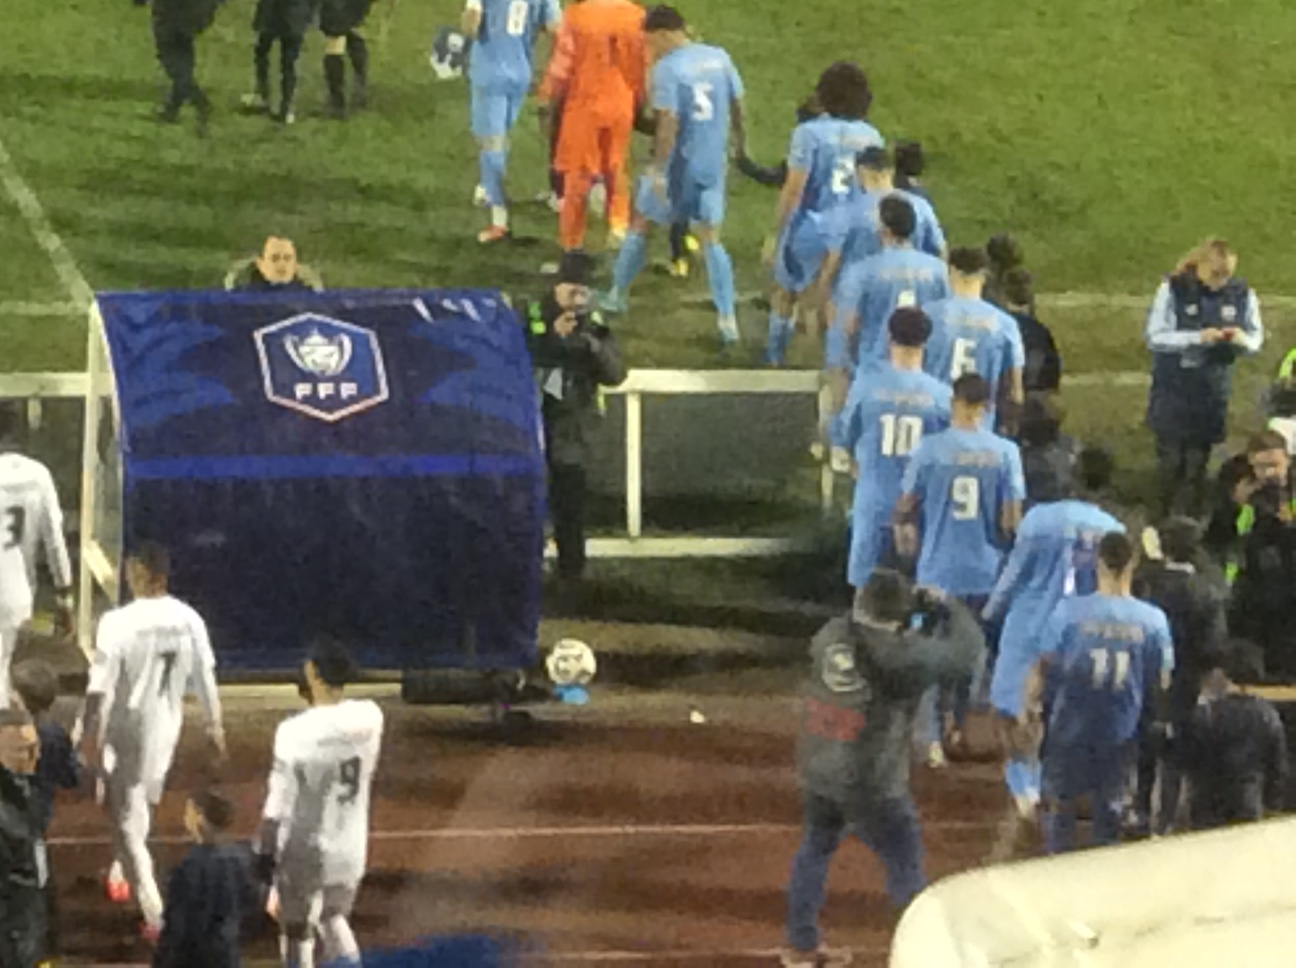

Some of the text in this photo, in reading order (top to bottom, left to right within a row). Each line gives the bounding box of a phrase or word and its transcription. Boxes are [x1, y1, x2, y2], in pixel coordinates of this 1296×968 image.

[294, 383, 358, 400] FFF
[880, 413, 923, 457] 10
[952, 476, 979, 521] 9
[4, 505, 25, 550] 3
[1089, 647, 1132, 690] 11
[338, 756, 361, 804] 9
